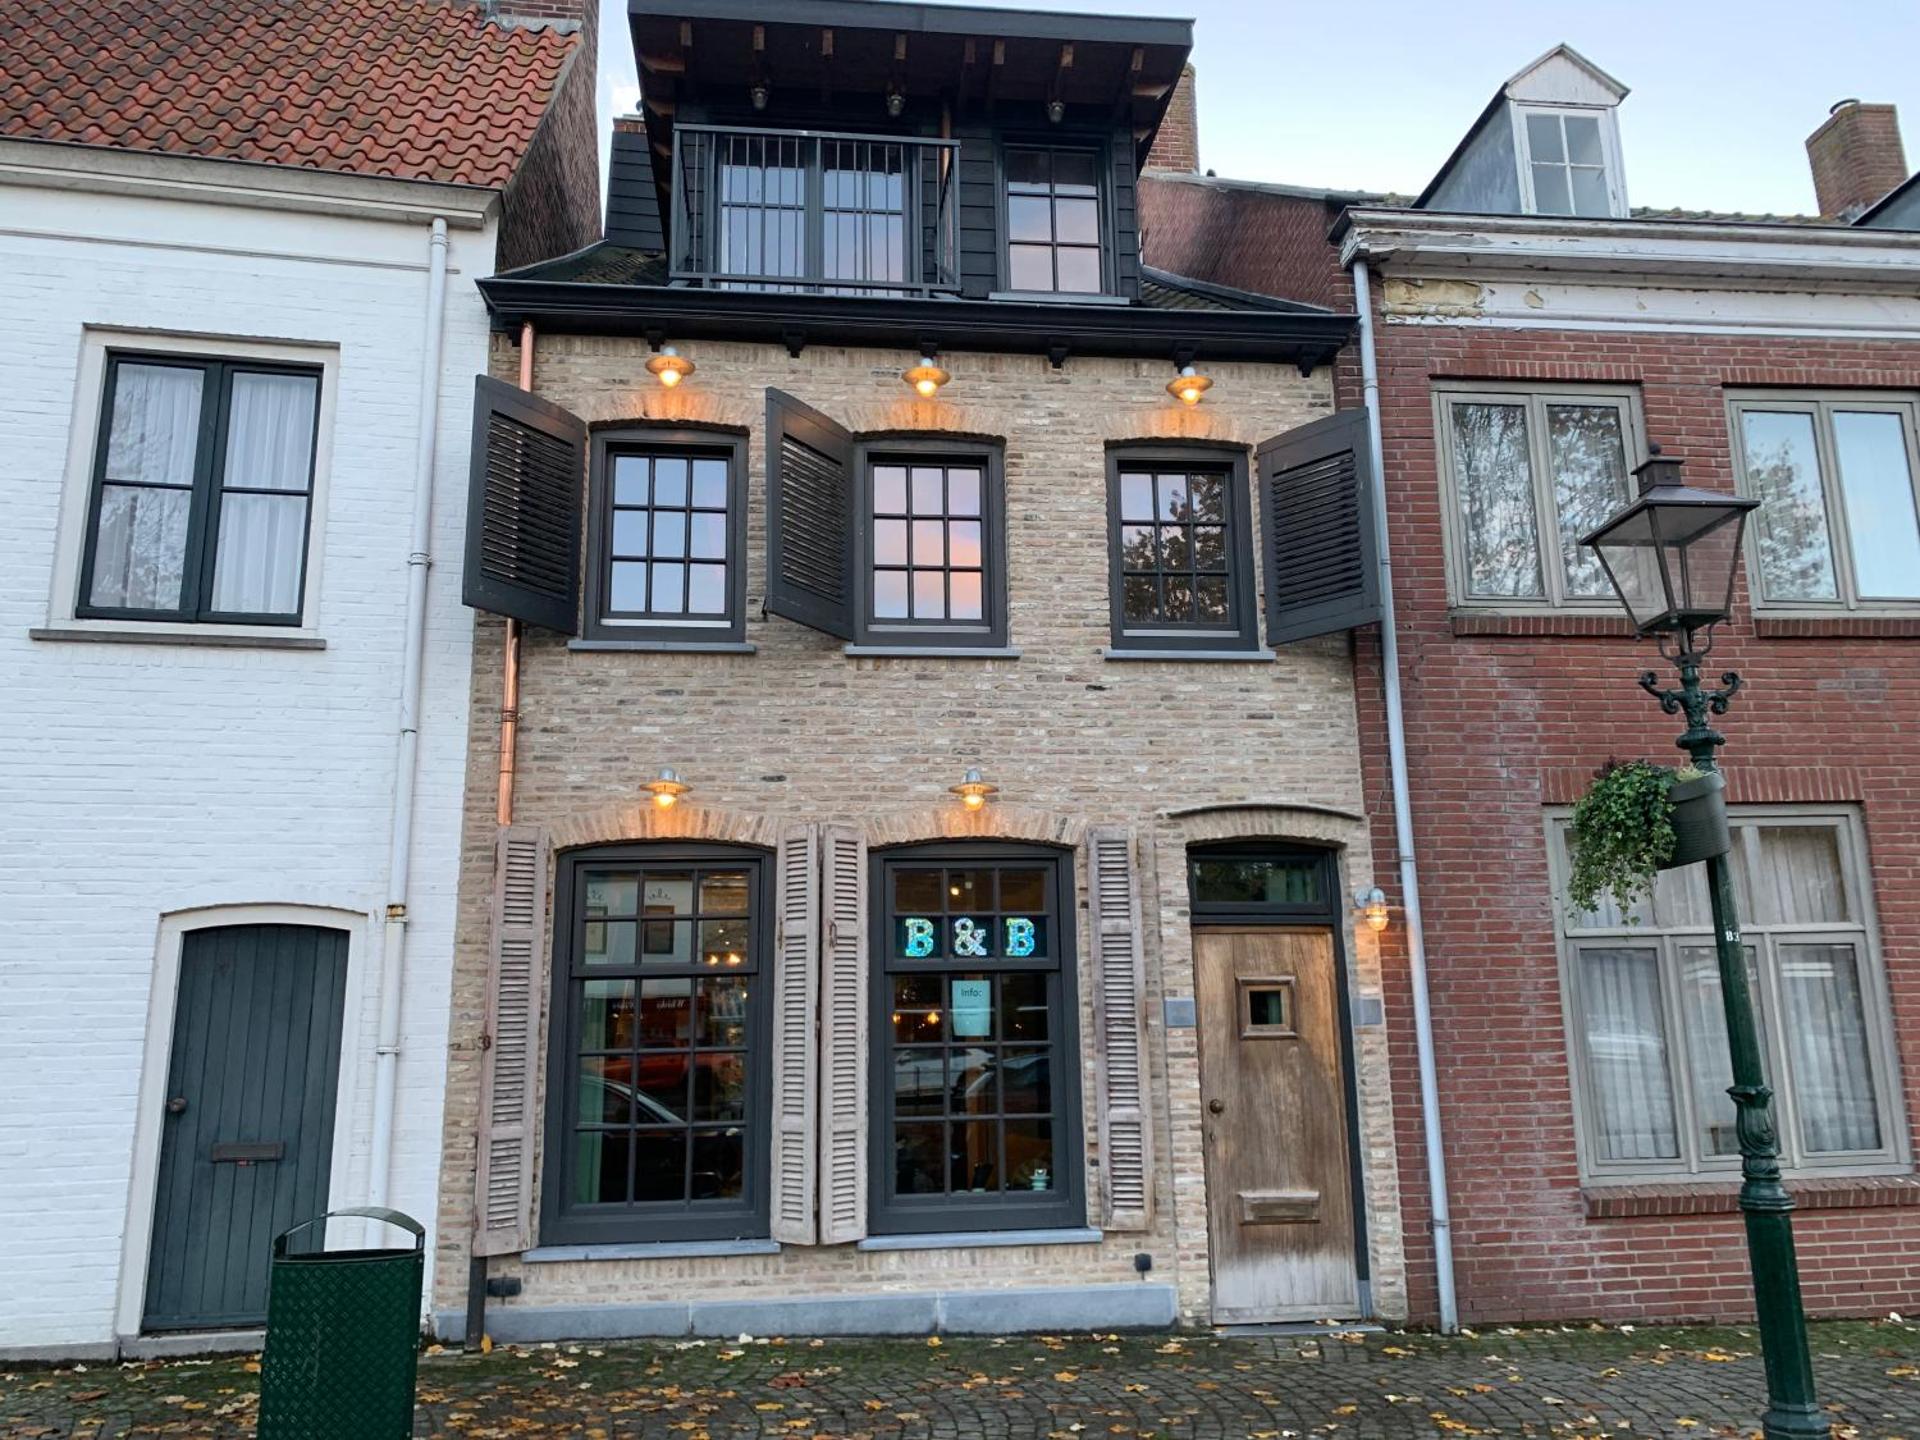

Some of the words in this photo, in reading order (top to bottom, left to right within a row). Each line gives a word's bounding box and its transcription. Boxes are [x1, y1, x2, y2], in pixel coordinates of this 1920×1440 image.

[905, 917, 934, 957] B
[954, 917, 987, 956] &
[1006, 917, 1035, 957] B
